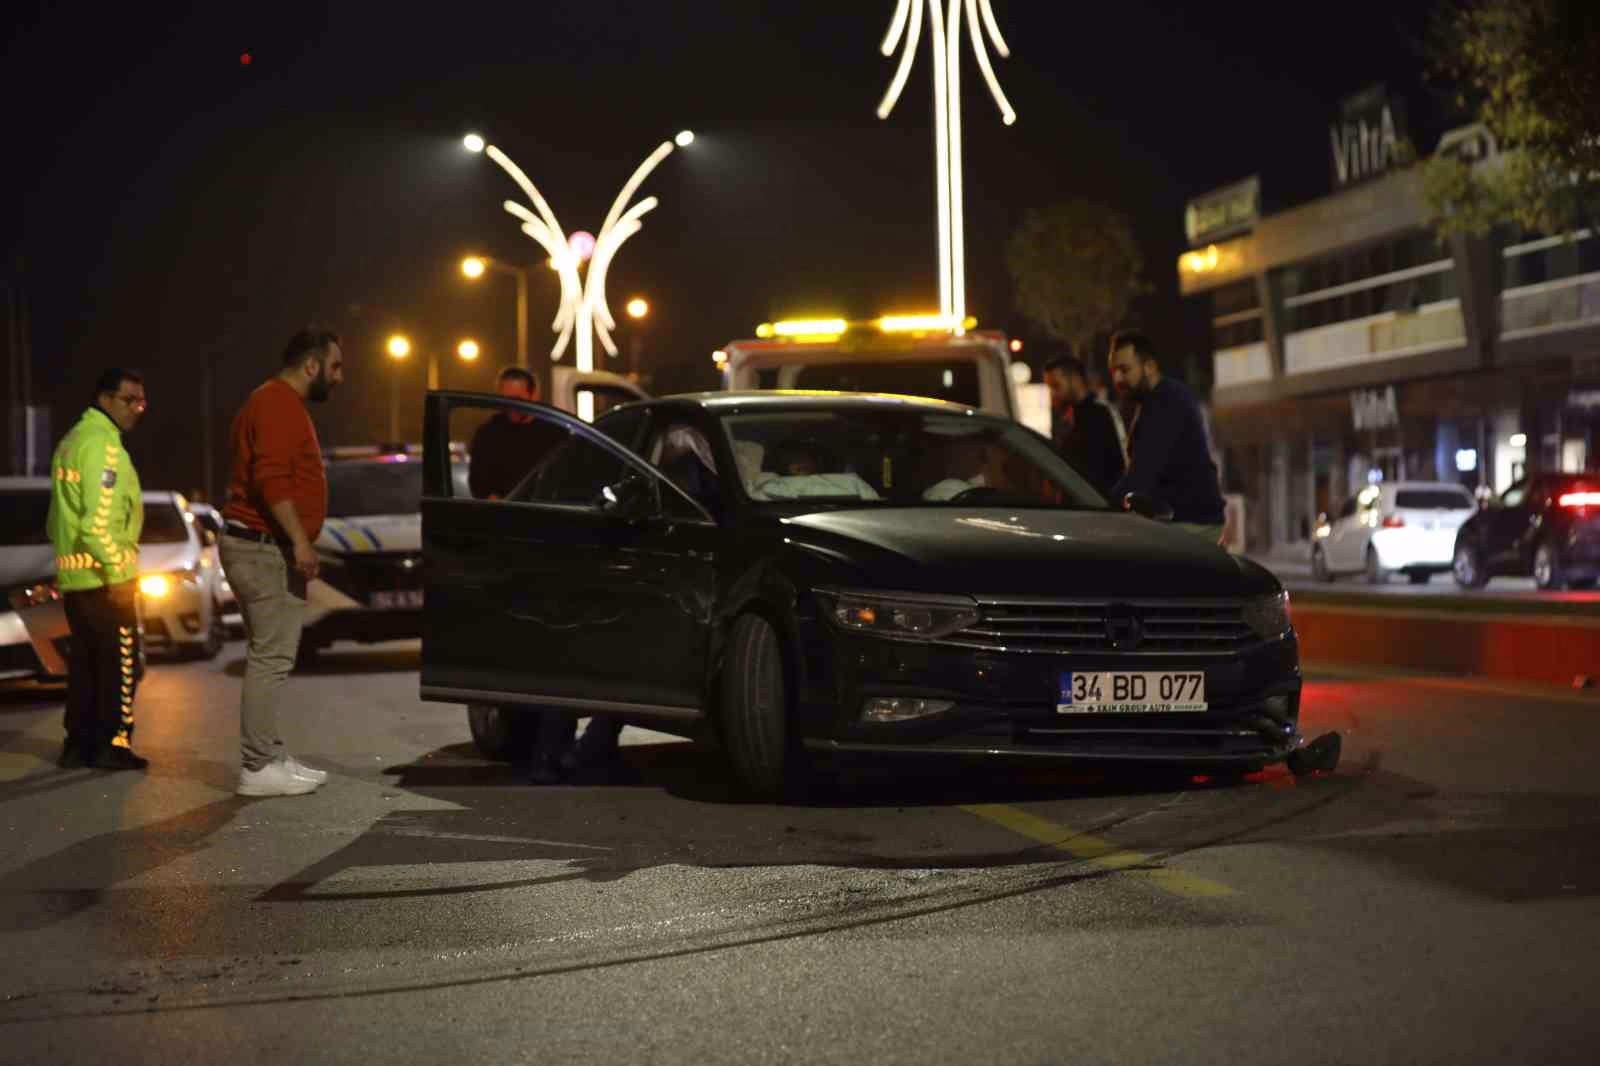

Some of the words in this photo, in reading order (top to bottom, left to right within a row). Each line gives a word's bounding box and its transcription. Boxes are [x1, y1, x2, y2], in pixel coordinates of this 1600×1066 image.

[1073, 675, 1101, 701] 34
[1113, 675, 1146, 700] BD
[1160, 675, 1202, 700] 077
